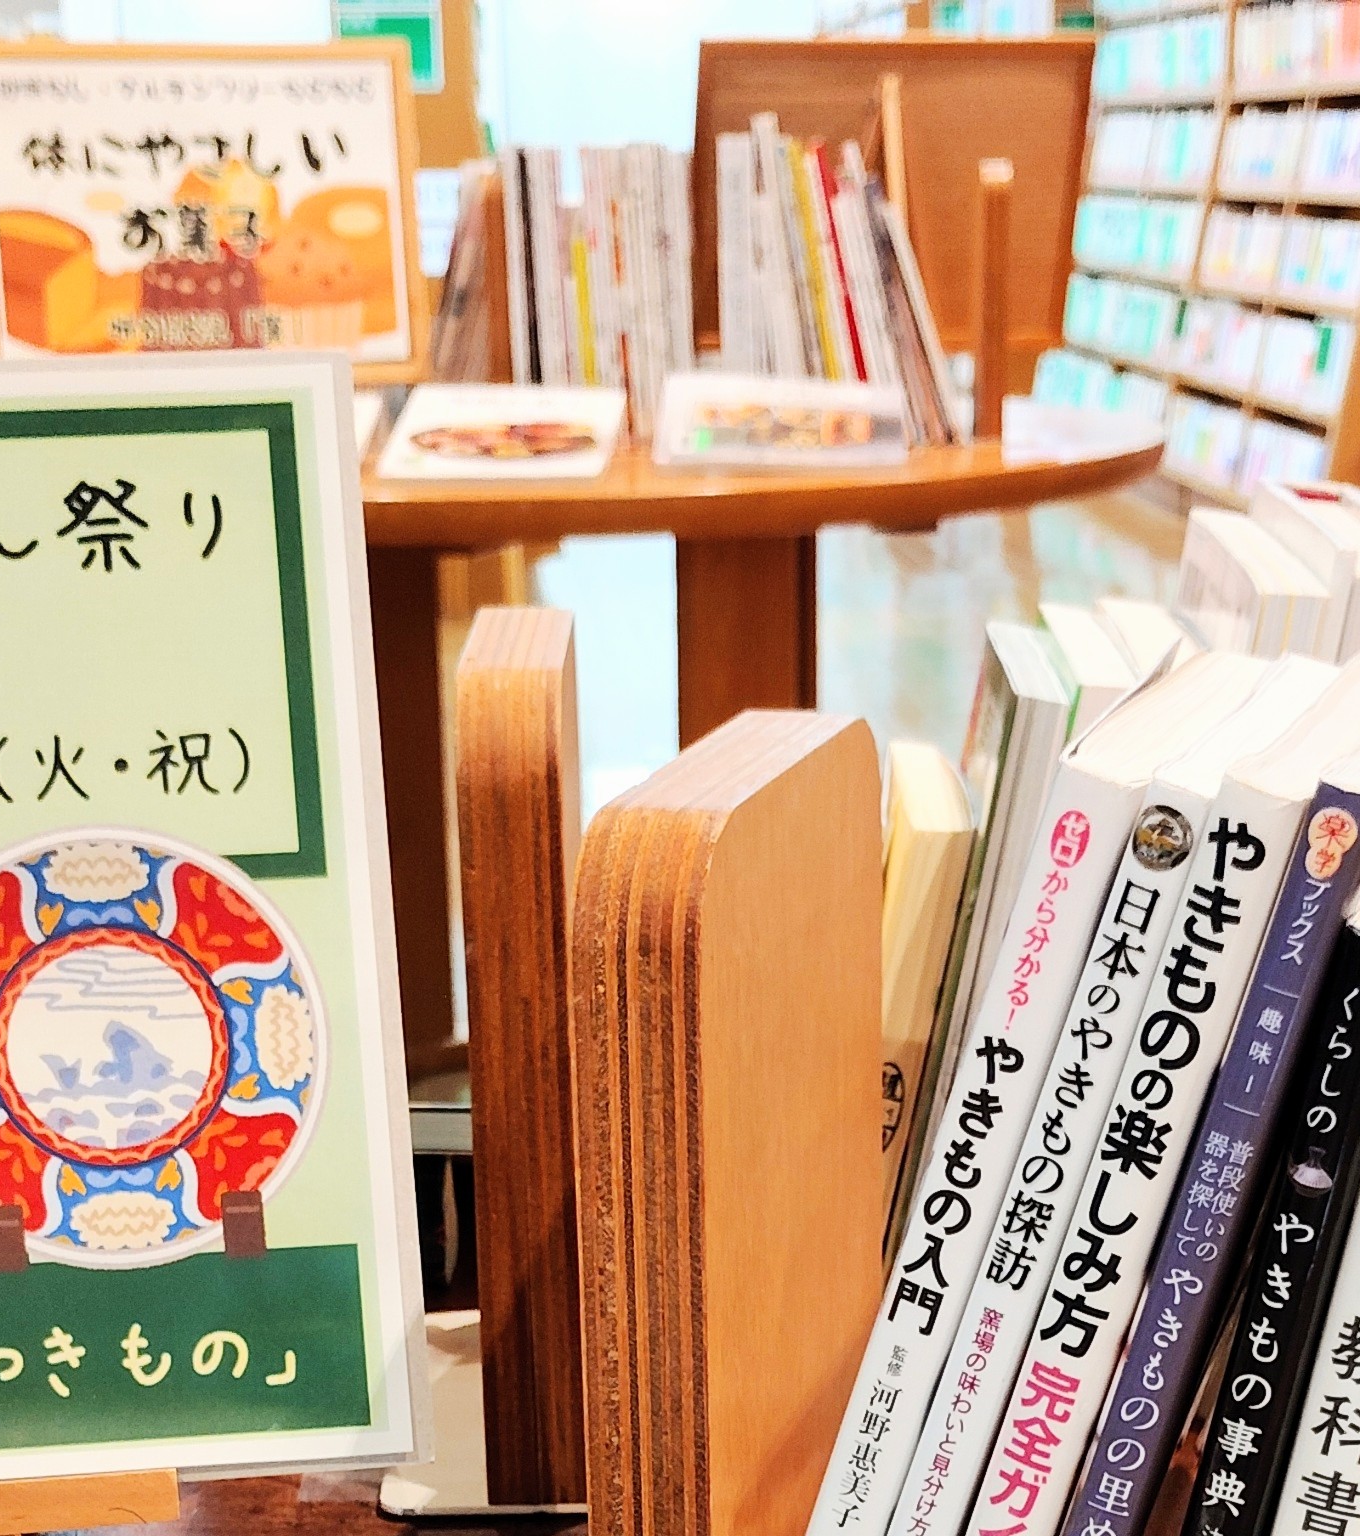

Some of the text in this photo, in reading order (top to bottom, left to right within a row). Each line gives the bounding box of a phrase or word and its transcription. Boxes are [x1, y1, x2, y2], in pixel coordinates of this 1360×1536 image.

[23, 131, 348, 179] 体にやさしい
[887, 1035, 1025, 1336] やきもの入門
[986, 879, 1161, 1291] 日本のやきもの探訪
[1039, 817, 1266, 1359] やきものの楽しみ方
[1198, 1140, 1254, 1263] 普段使いの
[886, 1345, 908, 1377] 監修
[1202, 1212, 1316, 1517] やきもの事典
